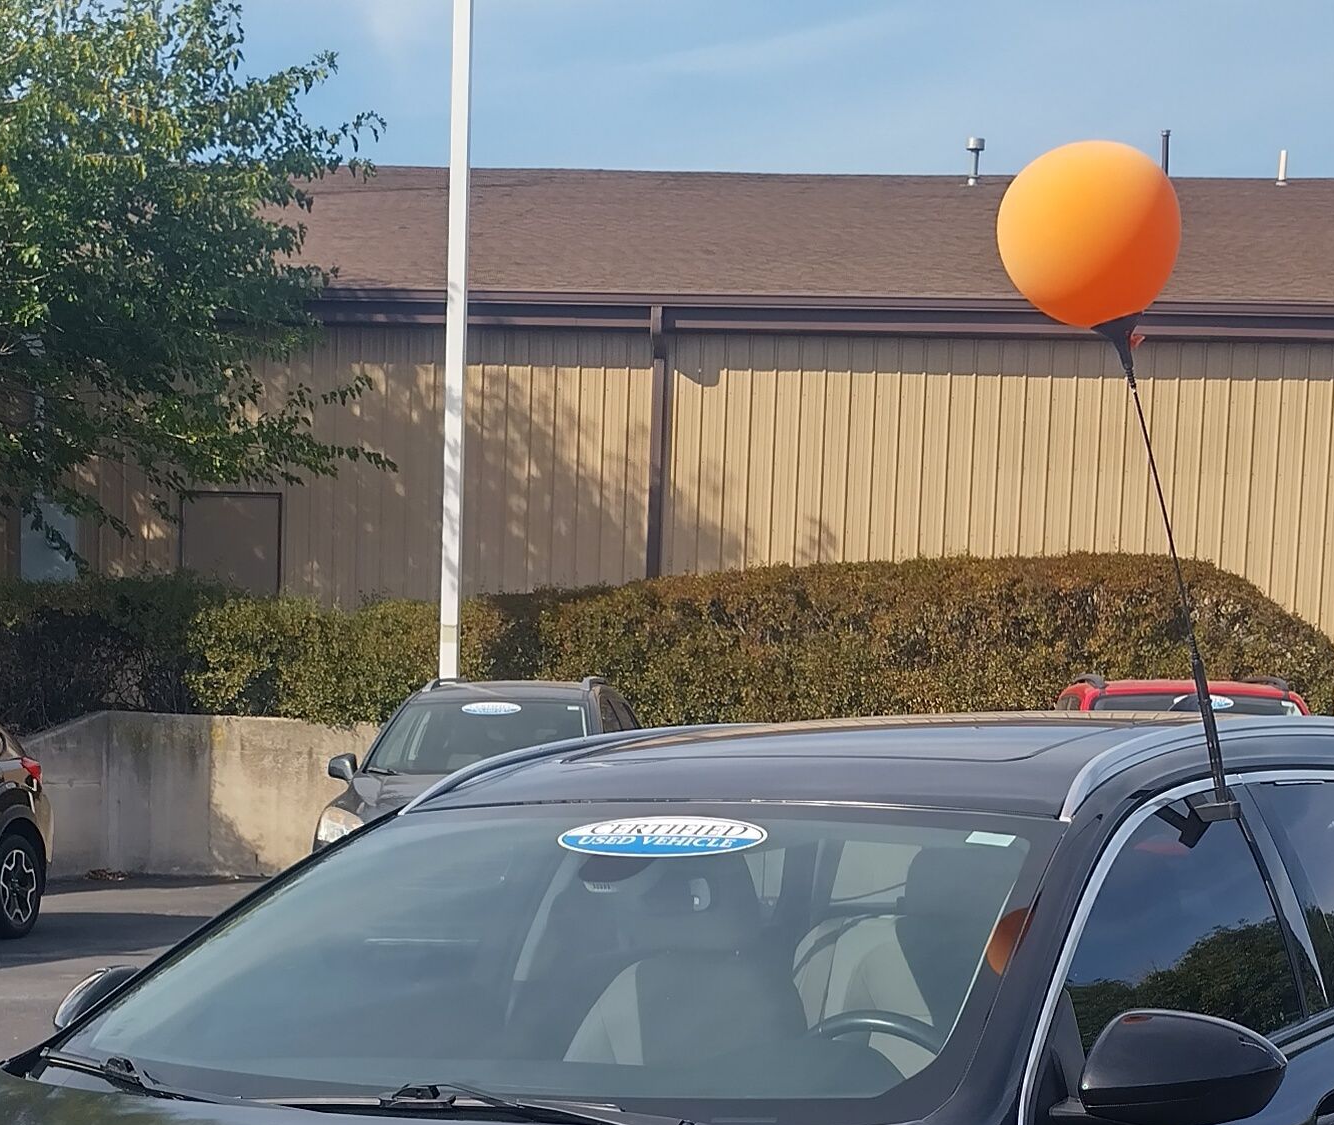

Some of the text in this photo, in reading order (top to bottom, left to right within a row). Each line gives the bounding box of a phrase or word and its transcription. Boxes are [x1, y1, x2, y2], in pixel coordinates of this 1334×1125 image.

[590, 823, 748, 837] CERTIFIED
[578, 835, 738, 848] USED VEHICLE
